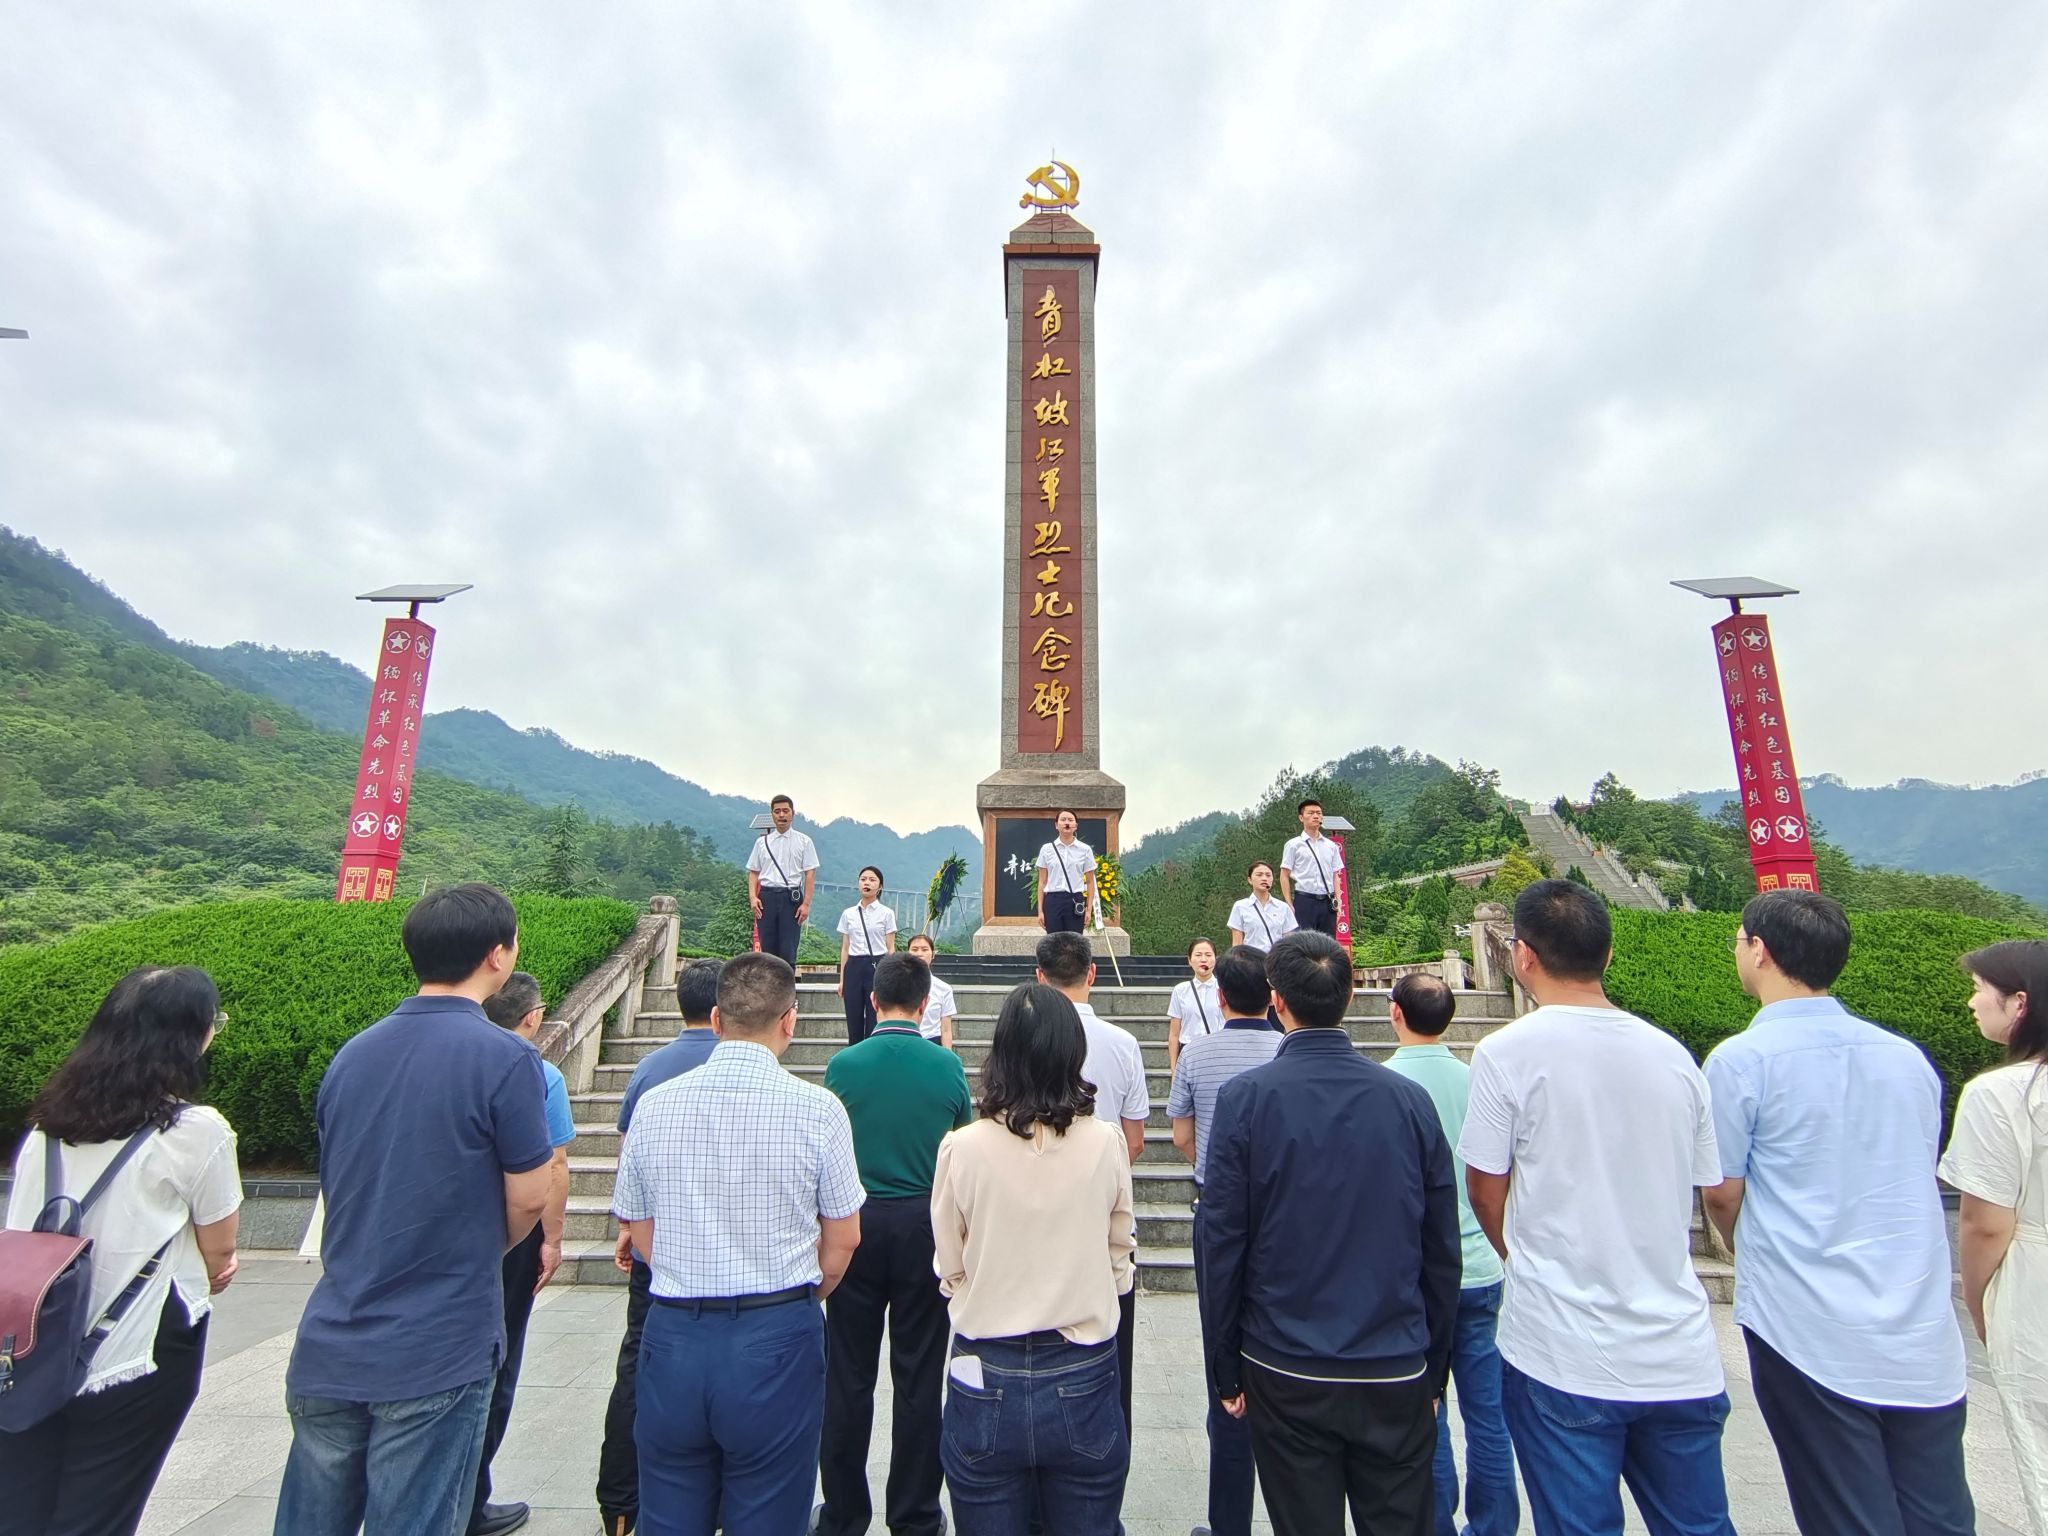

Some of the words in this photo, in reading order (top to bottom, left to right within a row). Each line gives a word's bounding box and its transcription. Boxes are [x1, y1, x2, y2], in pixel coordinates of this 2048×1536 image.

[363, 665, 401, 800] 缅怀革命先烈
[392, 671, 423, 804] 传承红色基因
[1724, 668, 1762, 807] 缅怀革命先烈
[1751, 662, 1790, 804] 传承红色基因
